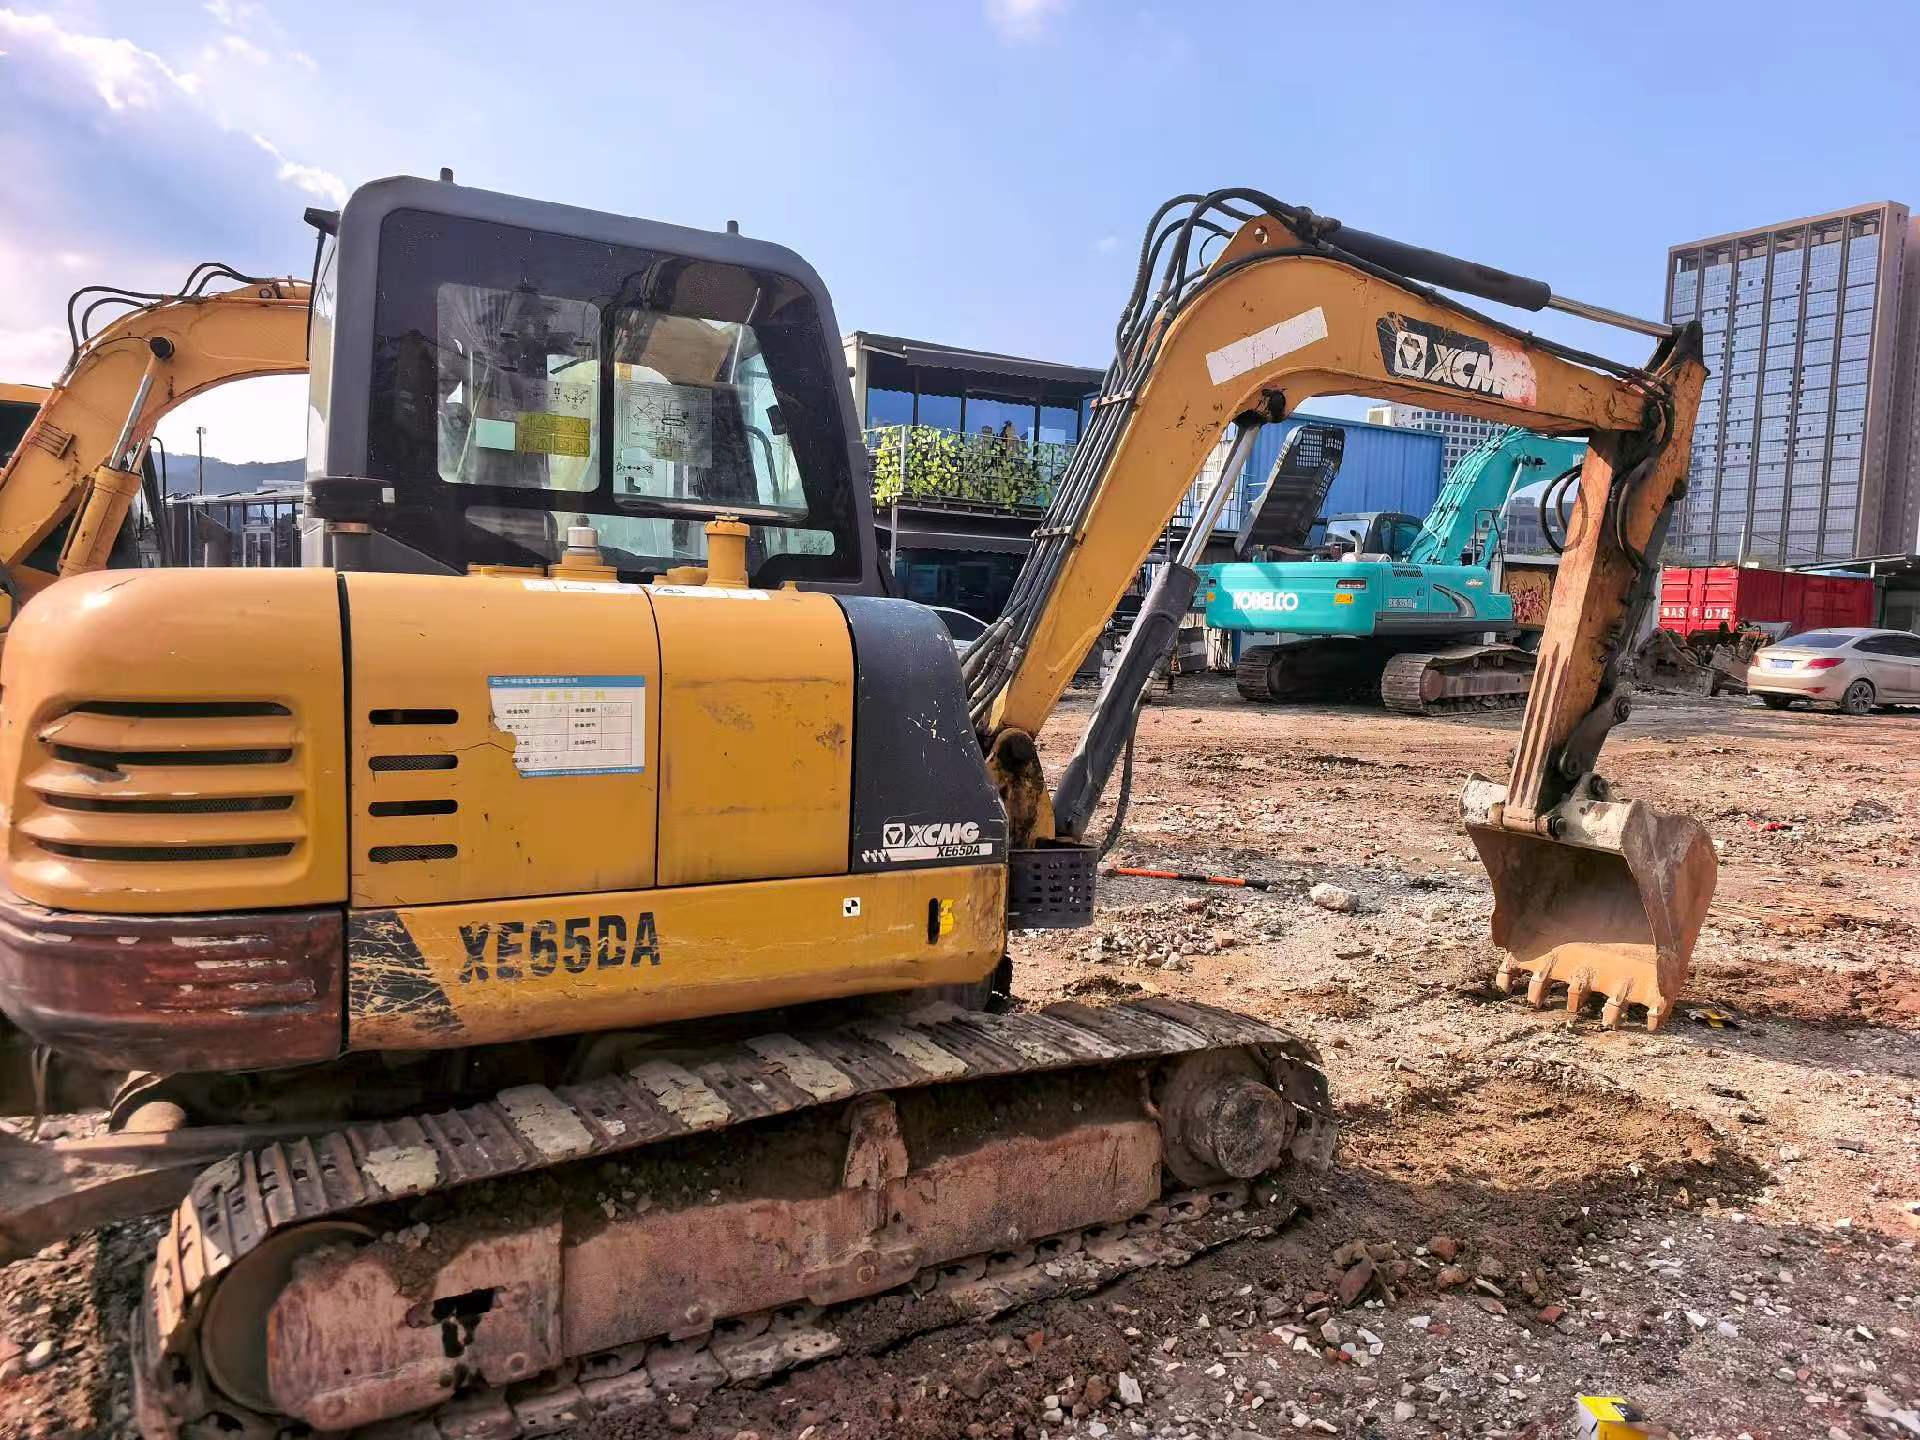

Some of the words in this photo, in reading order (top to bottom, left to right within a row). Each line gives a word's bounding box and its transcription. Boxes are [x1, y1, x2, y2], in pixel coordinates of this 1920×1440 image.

[904, 821, 980, 848] XCMG
[936, 844, 980, 858] XE65DA
[458, 911, 662, 984] XE65DA
